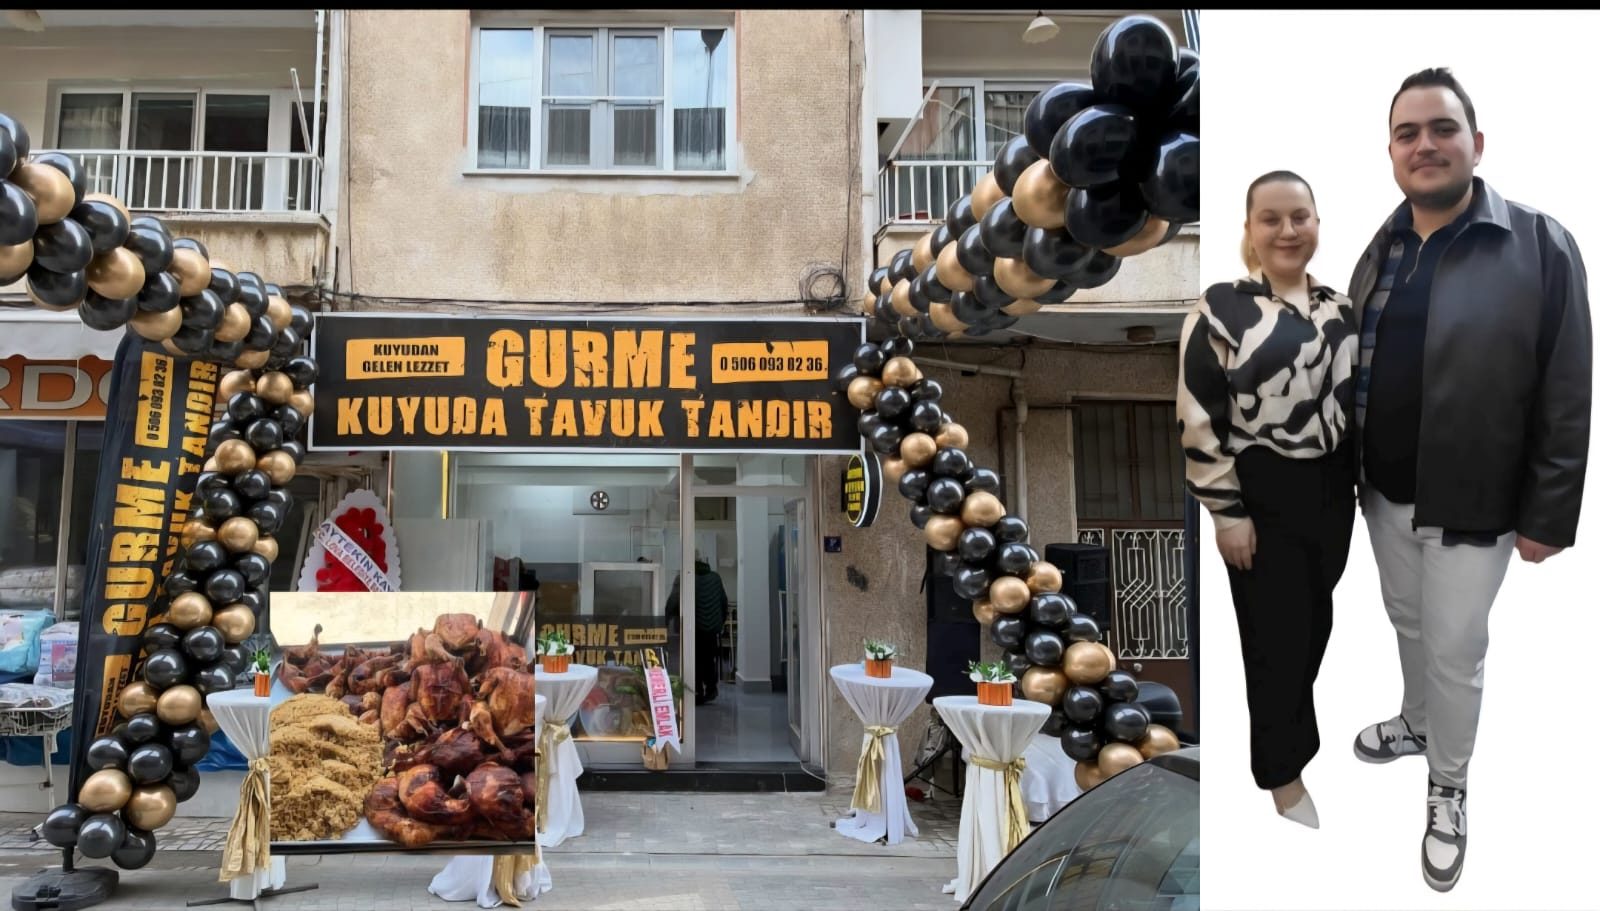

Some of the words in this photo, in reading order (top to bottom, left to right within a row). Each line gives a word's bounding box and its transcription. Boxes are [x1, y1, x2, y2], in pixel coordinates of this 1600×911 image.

[362, 361, 402, 373] GELEN
[406, 361, 449, 373] LEZZET
[373, 344, 439, 356] KUYUDAN
[486, 329, 697, 389] GURME
[720, 357, 727, 371] 0
[731, 357, 756, 371] 506
[759, 357, 784, 371] 093
[787, 357, 803, 371] 02
[178, 360, 218, 476] TANDIR
[337, 396, 508, 436] KUYUDA
[524, 399, 664, 437] TAVUK
[681, 400, 833, 439] TANDIR
[103, 457, 171, 636] GURME
